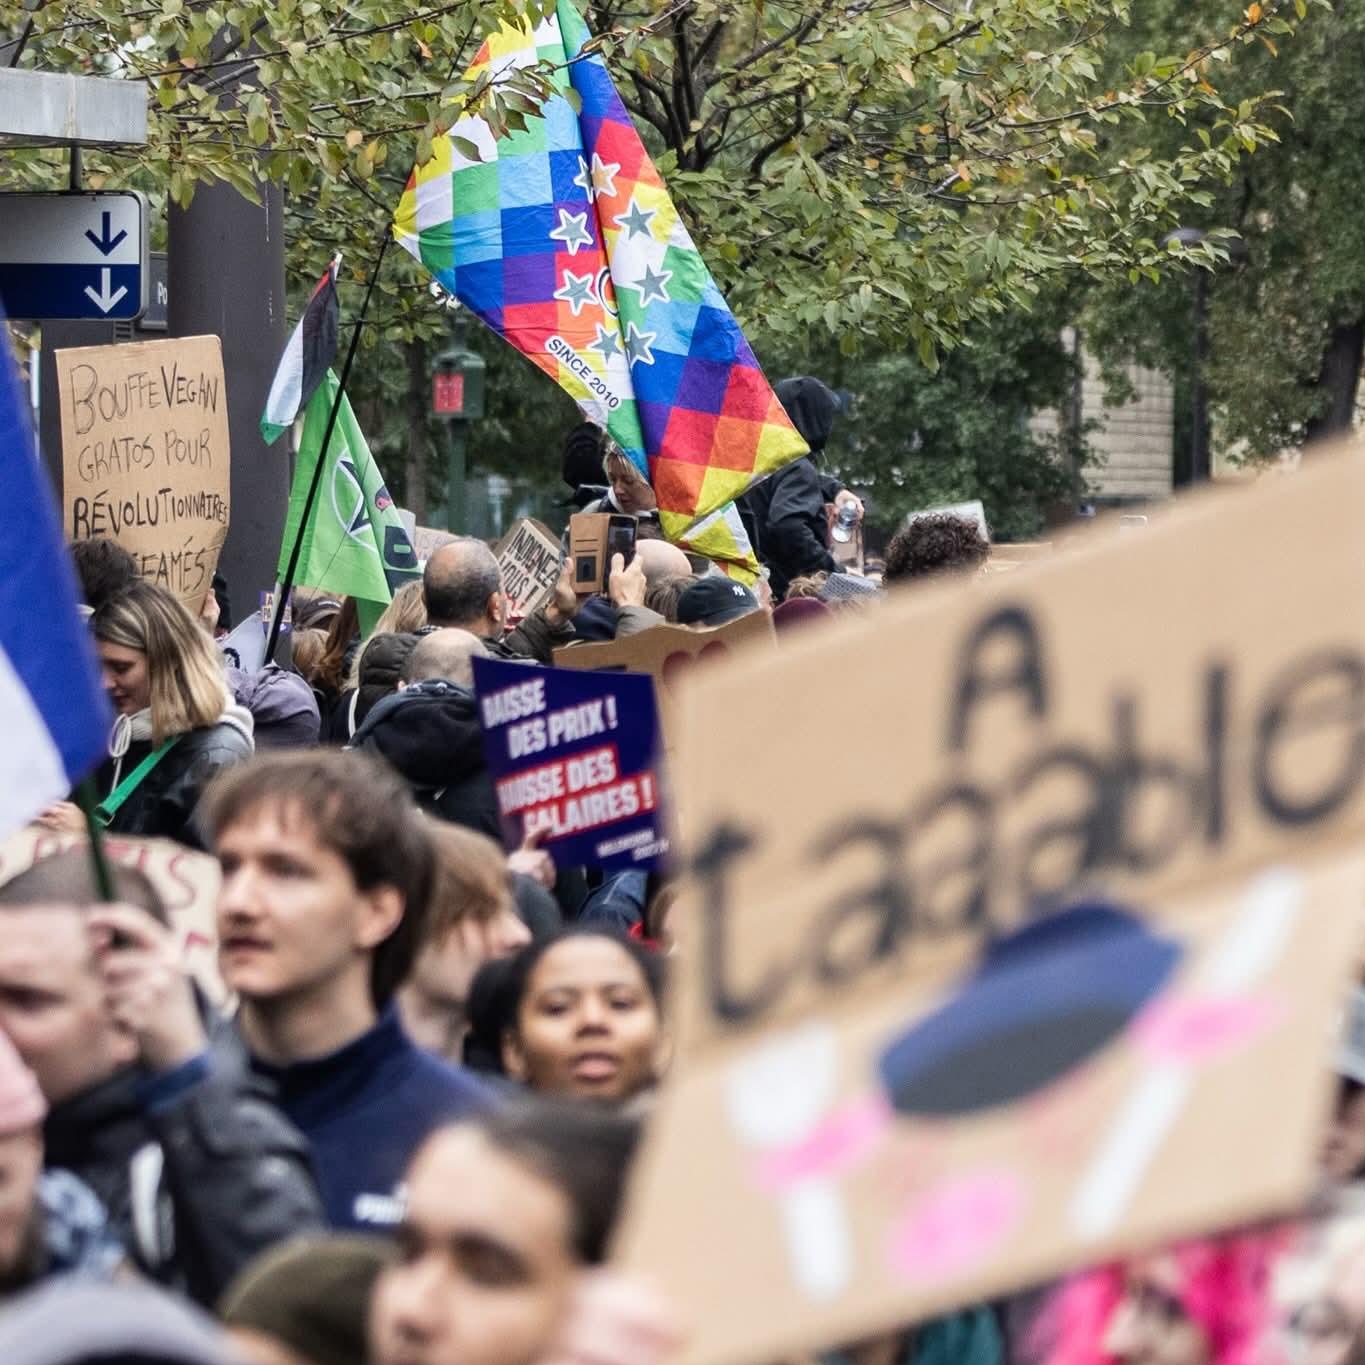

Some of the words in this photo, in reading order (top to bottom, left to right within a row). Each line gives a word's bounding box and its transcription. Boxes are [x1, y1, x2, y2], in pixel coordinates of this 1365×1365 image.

[157, 281, 168, 305] Po
[70, 364, 161, 435] BOUFFE
[161, 361, 219, 414] VEGAN
[549, 338, 592, 380] SINCE
[589, 376, 620, 409] 2010
[78, 433, 156, 482] GRATOS
[164, 427, 212, 468] POUR
[73, 488, 228, 539] RÉVOLUTIONNAIRES
[133, 536, 206, 592] FAMÉS
[507, 717, 548, 760] DES
[566, 748, 617, 794] DES
